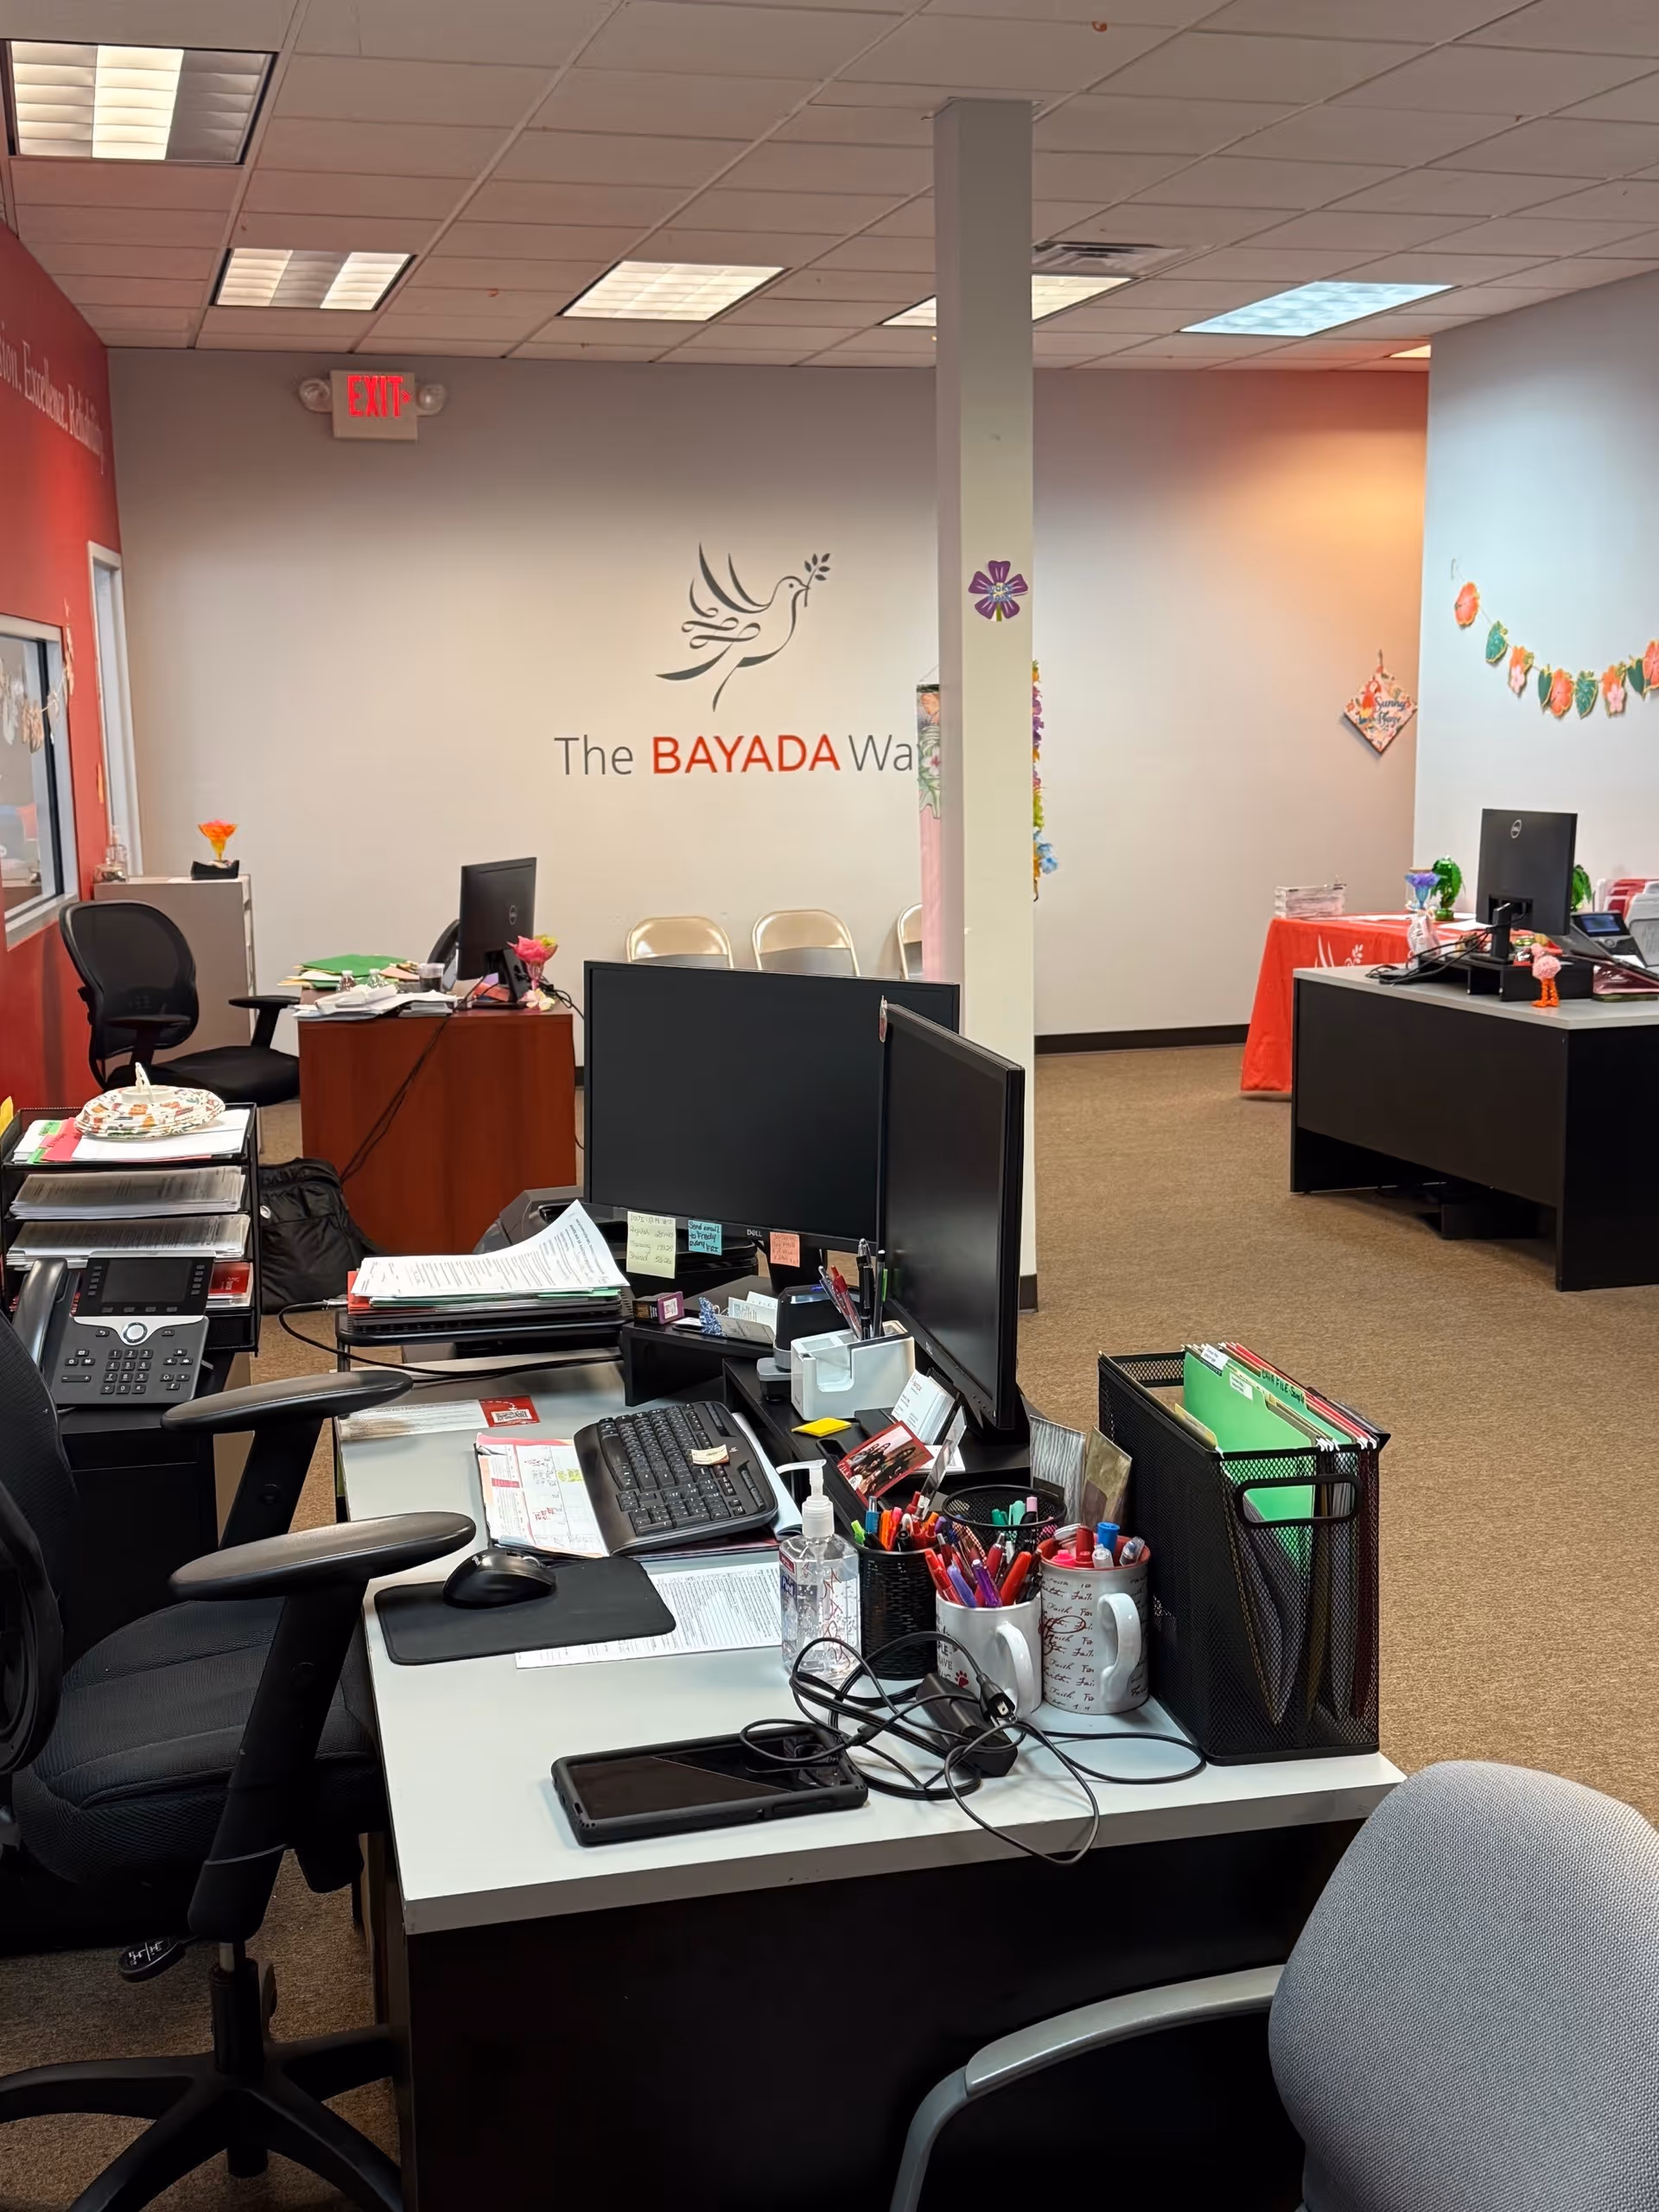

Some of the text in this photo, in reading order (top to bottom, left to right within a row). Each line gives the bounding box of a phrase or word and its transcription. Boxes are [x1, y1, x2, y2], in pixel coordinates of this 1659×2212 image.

[347, 374, 404, 416] EXIT
[1374, 696, 1408, 712] Sunny
[554, 734, 917, 775] The BAYADA Wa
[689, 1220, 702, 1230] Send
[747, 1229, 762, 1237] DELL
[1046, 1602, 1073, 1613] Faith
